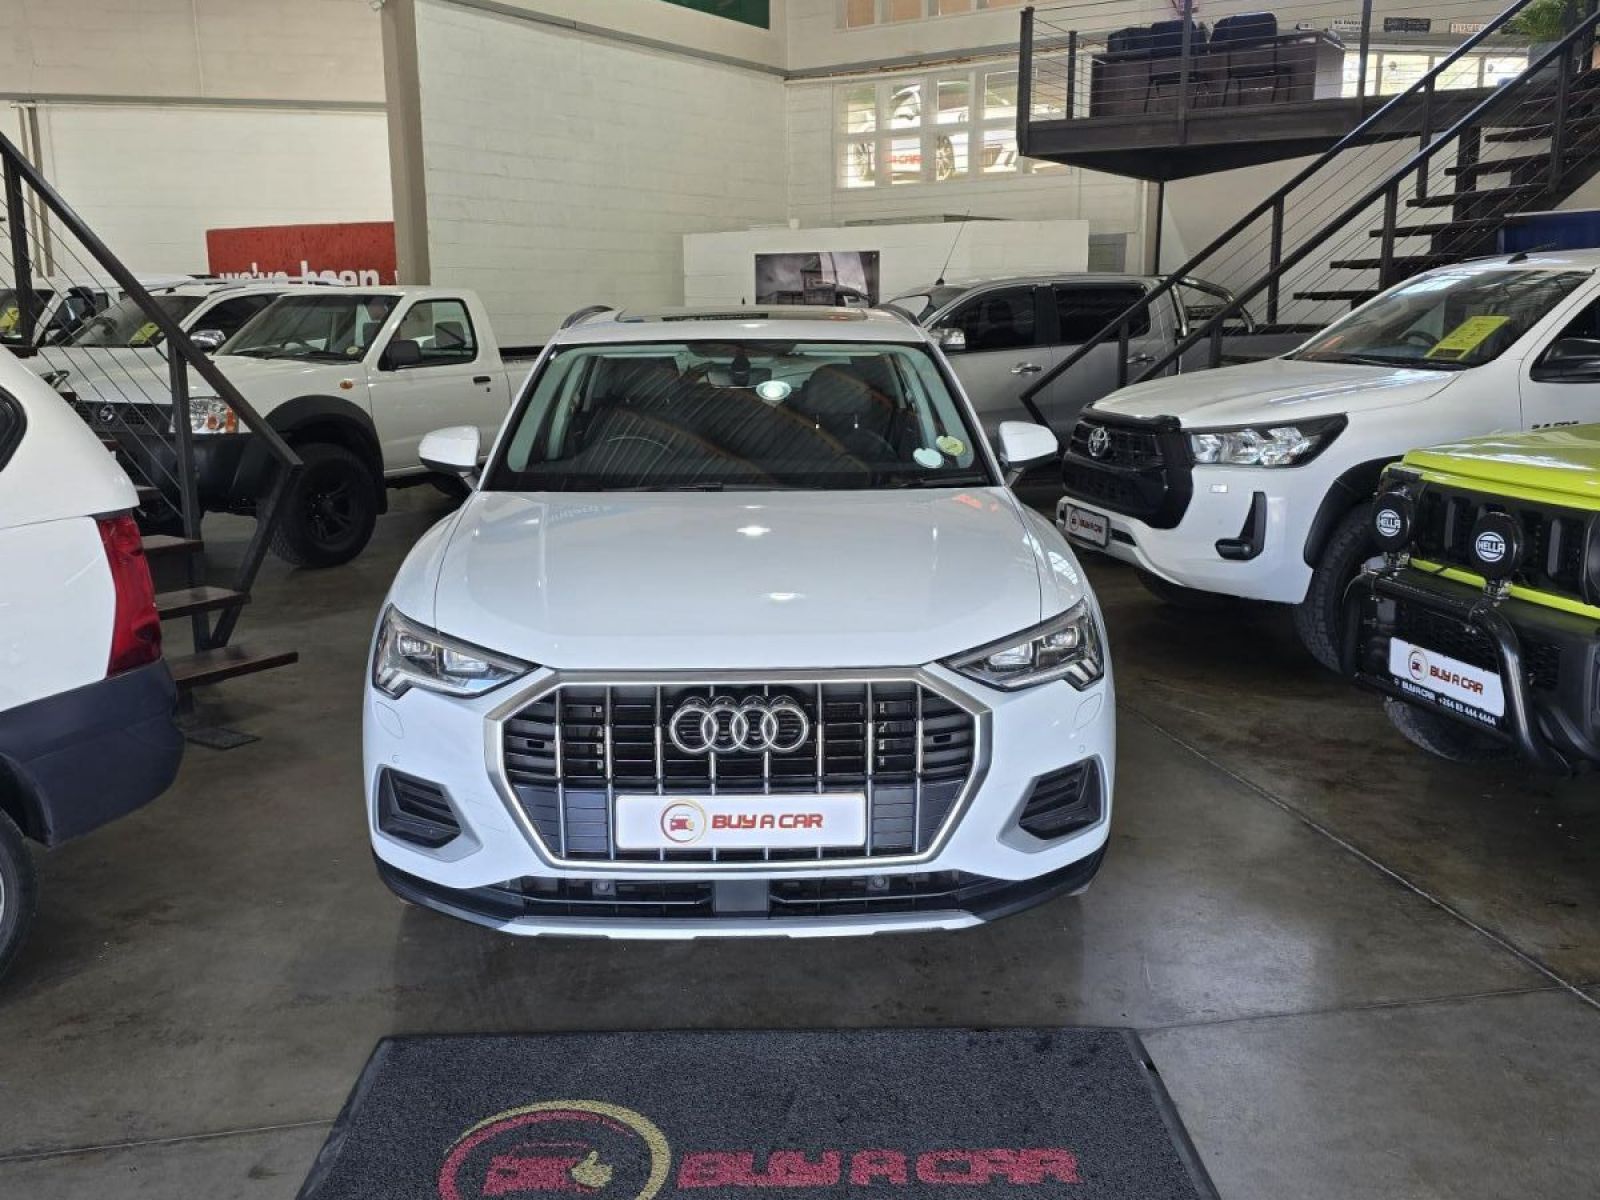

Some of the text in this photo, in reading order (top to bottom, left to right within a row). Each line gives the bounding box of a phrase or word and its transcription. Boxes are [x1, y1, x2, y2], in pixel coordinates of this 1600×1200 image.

[1378, 518, 1401, 529] HELLA
[1478, 541, 1505, 554] HELLA
[1430, 664, 1484, 695] BUY A CAR
[711, 813, 824, 830] BUY A CAR
[677, 1146, 1084, 1189] BUY A CAR
